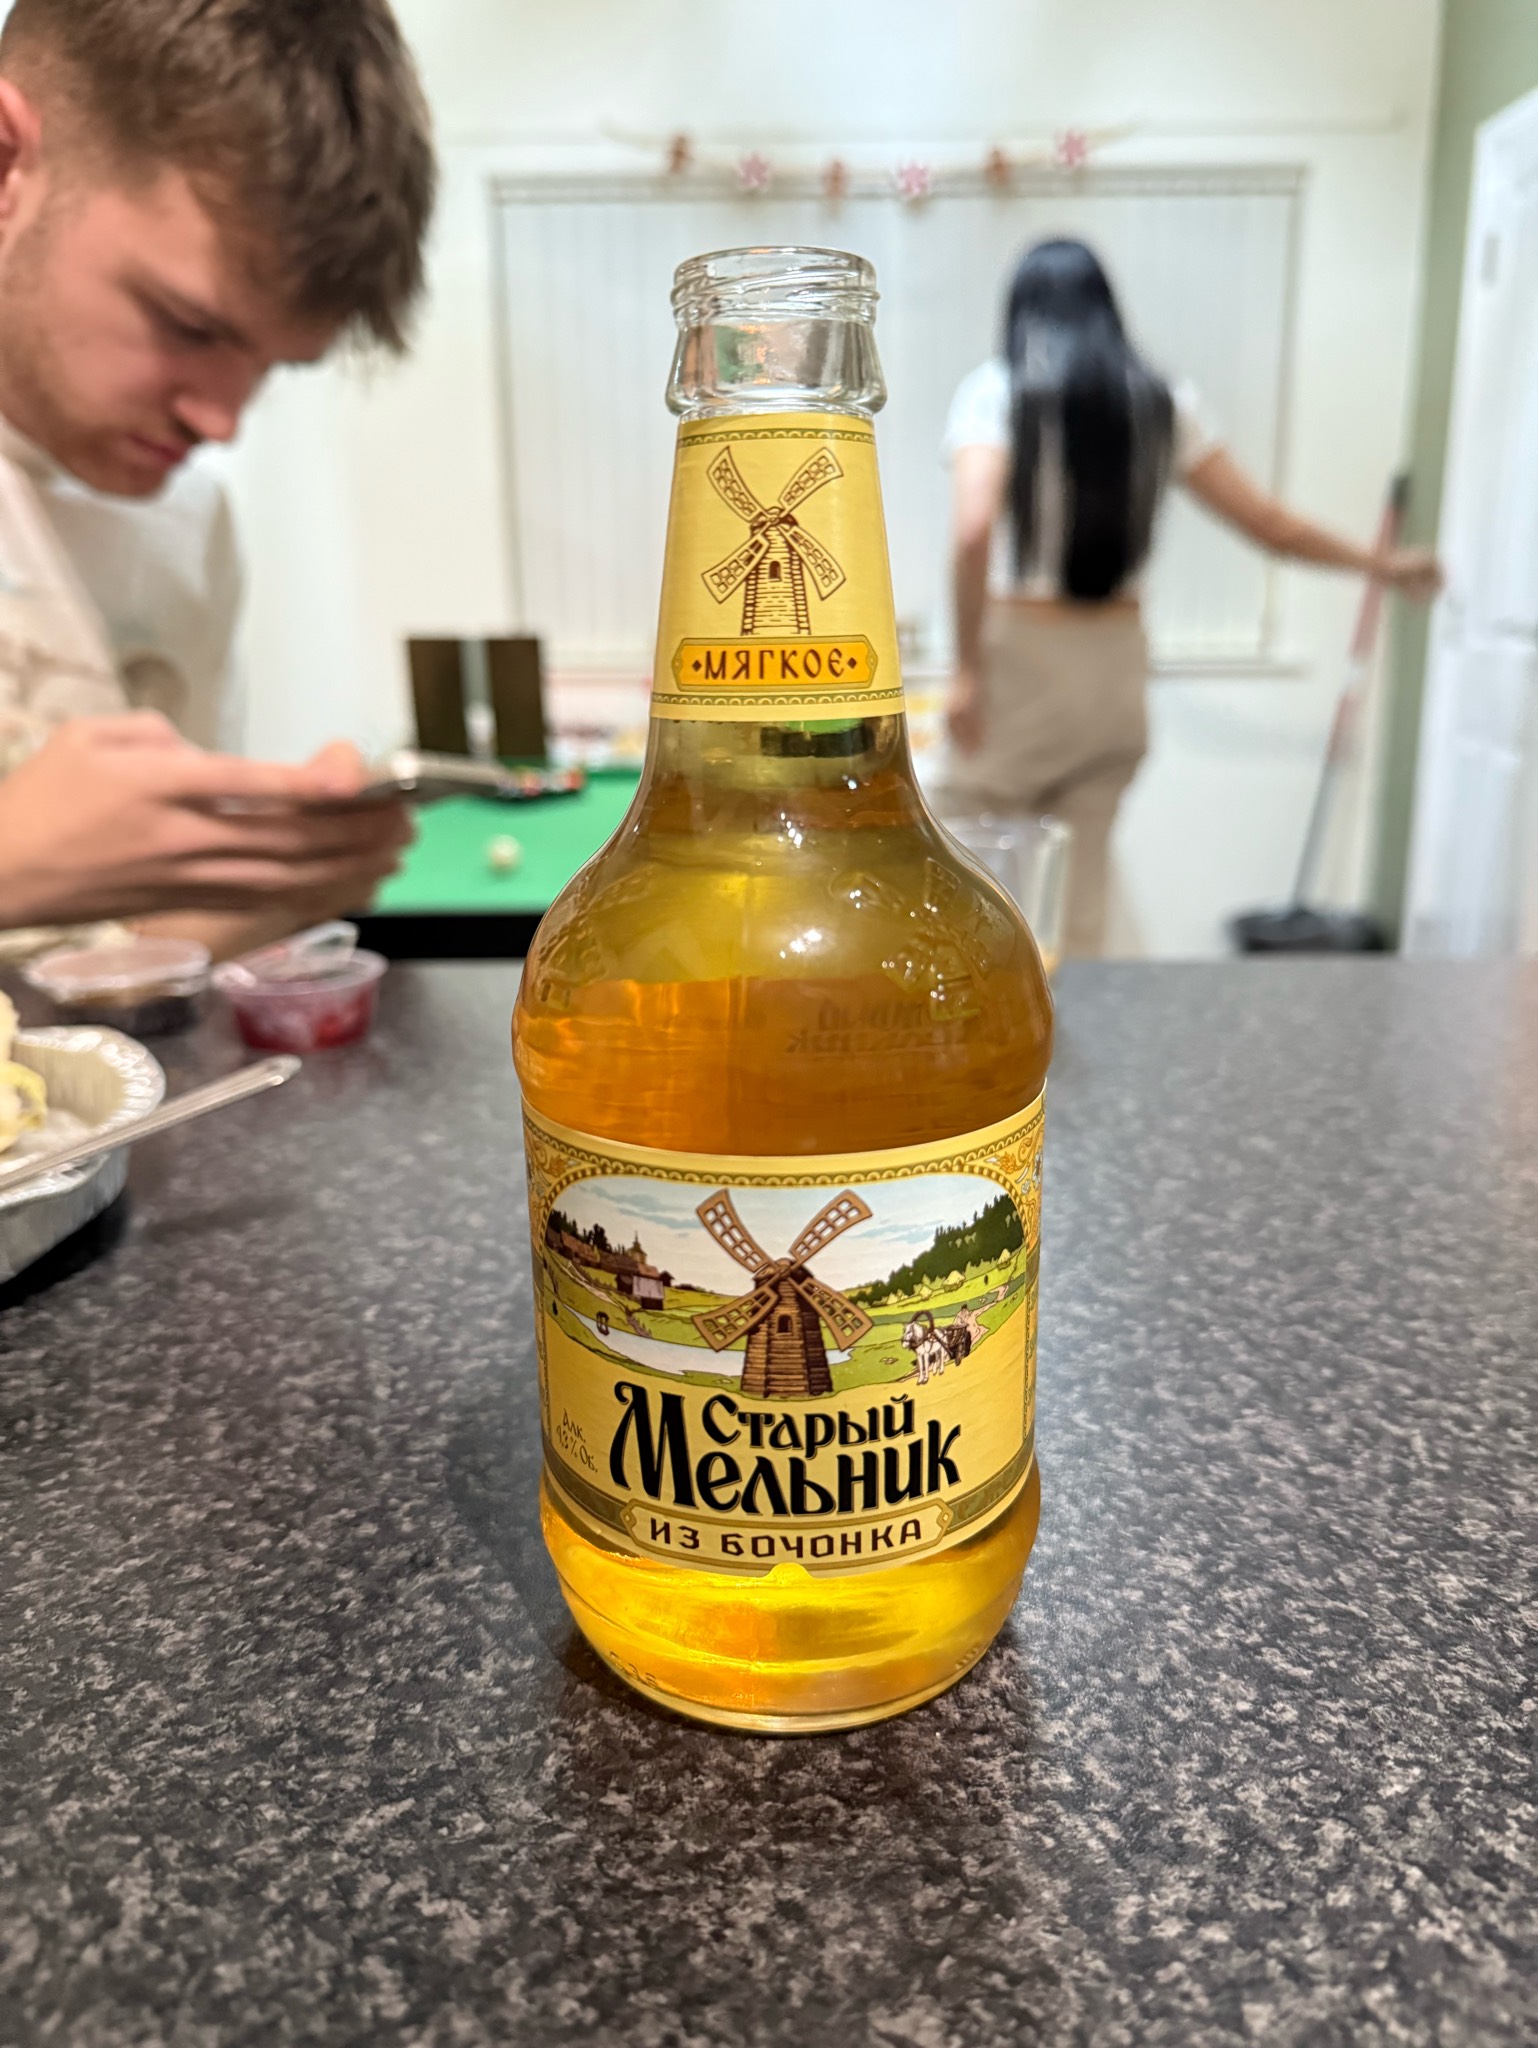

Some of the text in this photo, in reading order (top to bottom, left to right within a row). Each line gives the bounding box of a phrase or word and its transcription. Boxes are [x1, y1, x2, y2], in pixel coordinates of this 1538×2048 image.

[703, 648, 846, 680] МЯГКОЕ
[609, 1380, 962, 1517] Мельник
[702, 1391, 915, 1459] Старый
[649, 1518, 922, 1558] ИЗ БОЧОНКА
